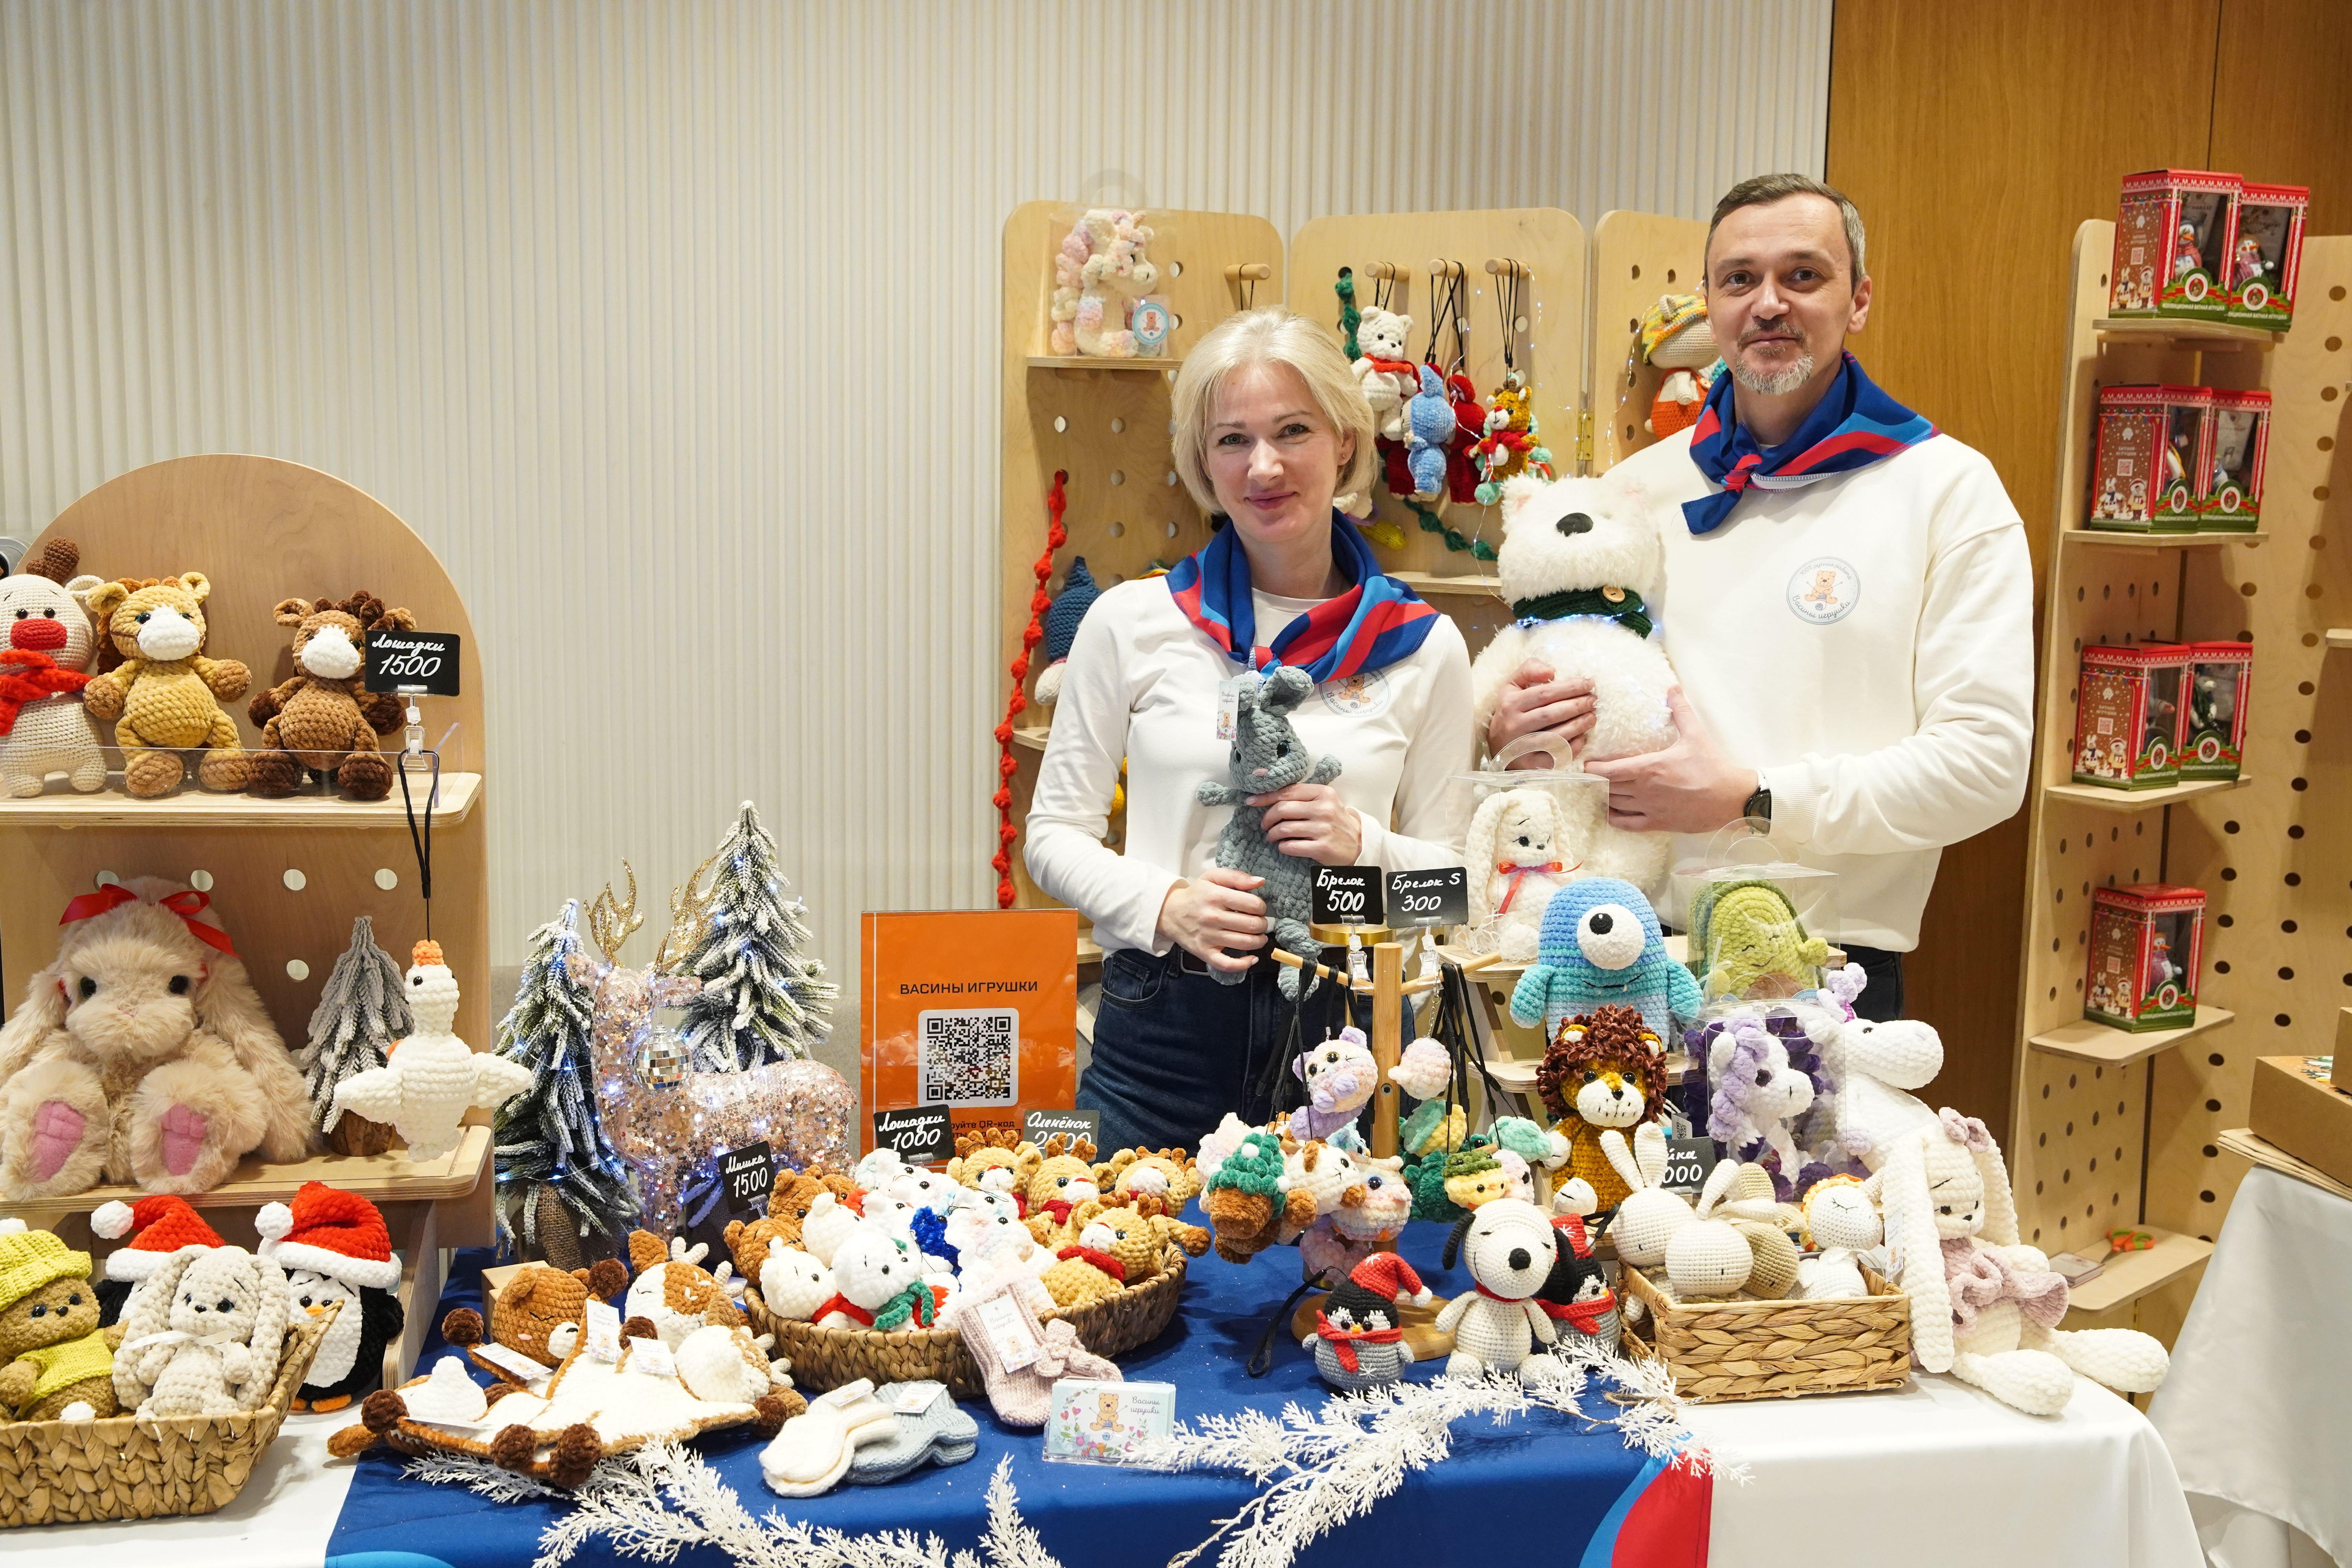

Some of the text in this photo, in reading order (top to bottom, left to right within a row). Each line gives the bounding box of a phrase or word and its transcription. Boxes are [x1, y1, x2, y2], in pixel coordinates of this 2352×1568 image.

[1800, 564, 1813, 575] 100%
[1834, 564, 1851, 581] работа
[1792, 593, 1851, 620] Васины игрушки
[372, 633, 445, 657] Лошадки
[379, 654, 441, 677] 1500
[1326, 691, 1352, 714] Васины
[1316, 868, 1365, 891] Брелок
[1391, 872, 1461, 894] Брелок S
[1327, 890, 1365, 912] 500
[1401, 895, 1441, 912] 300
[900, 981, 1038, 994] ВАСИНЫ ИГРУШКИ
[878, 1112, 945, 1133] Лошадки
[979, 1120, 1015, 1130] QR-код
[1027, 1111, 1092, 1129] Оленёнок
[891, 1128, 941, 1151] 1000
[726, 1154, 766, 1174] Мишка
[733, 1167, 768, 1198] 1500
[989, 1311, 1013, 1323] Васины
[992, 1317, 1016, 1330] игрушки
[1131, 1406, 1160, 1415] игрушки
[1132, 1396, 1160, 1405] Васины
